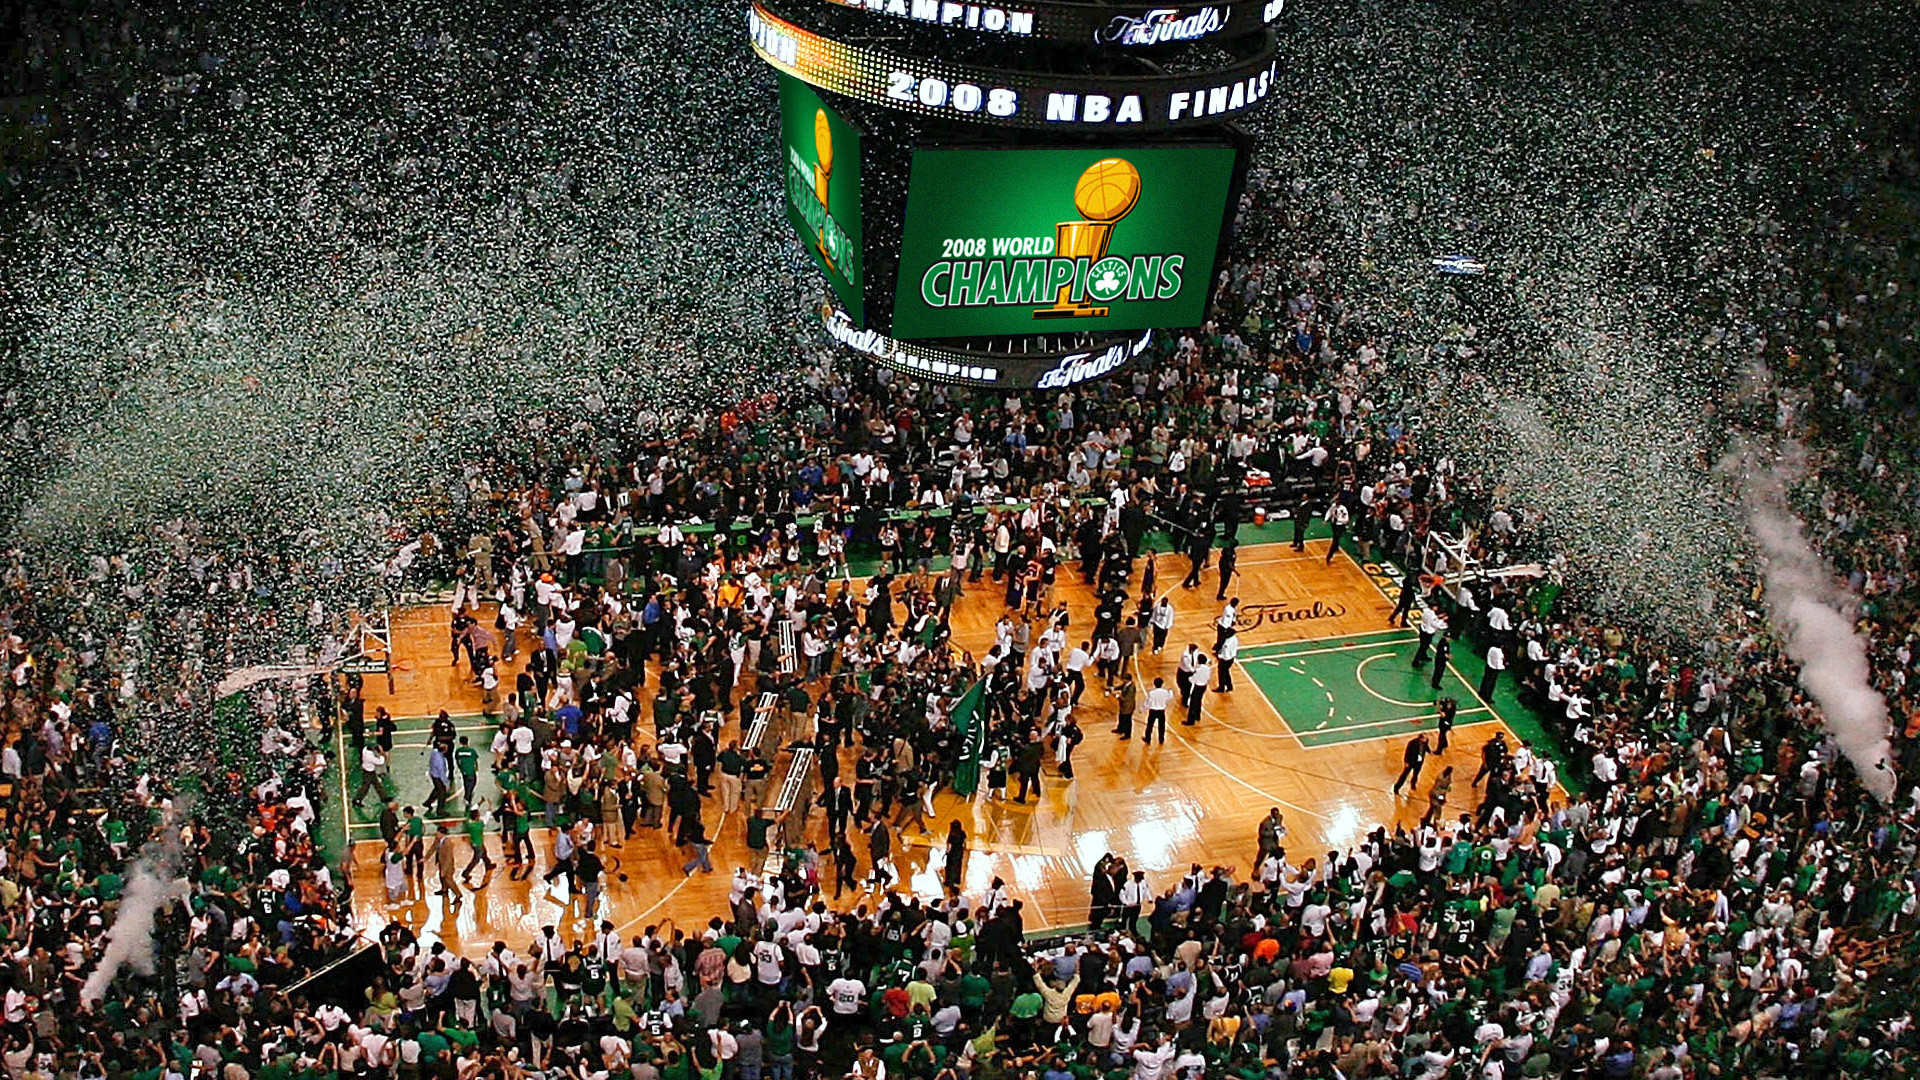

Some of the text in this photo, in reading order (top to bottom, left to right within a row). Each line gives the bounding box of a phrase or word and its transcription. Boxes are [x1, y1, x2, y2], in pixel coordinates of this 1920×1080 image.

[1143, 7, 1230, 45] Finals
[887, 70, 1269, 122] 2008 NBA FINALS
[941, 236, 1055, 258] 2008 WORLD
[920, 253, 1185, 308] CHAMPIONS
[1091, 261, 1127, 278] CELTICS
[834, 309, 898, 358] Finals
[895, 351, 998, 382] CHAMPION
[1060, 339, 1131, 388] Finals
[1238, 601, 1346, 633] Finals
